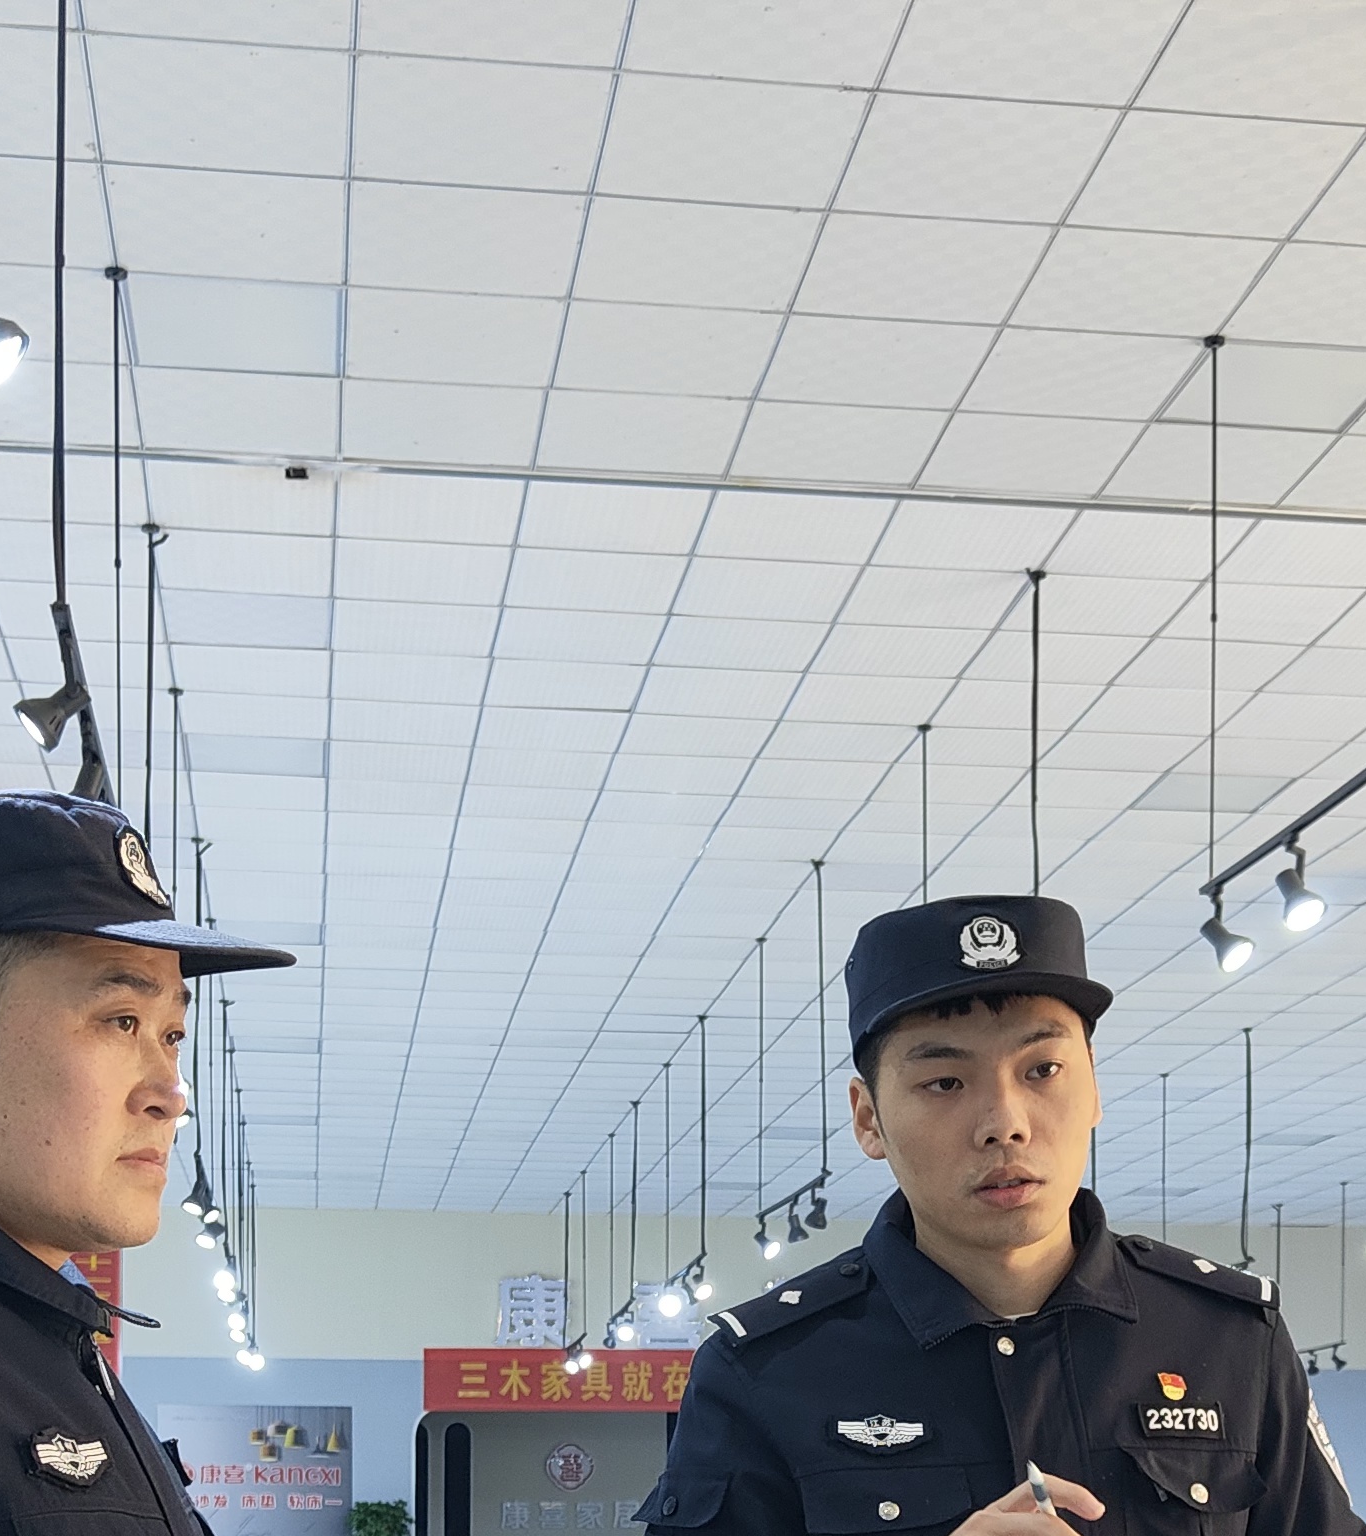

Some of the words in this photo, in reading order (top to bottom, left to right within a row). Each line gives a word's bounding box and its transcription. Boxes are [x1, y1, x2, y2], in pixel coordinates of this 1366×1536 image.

[978, 959, 1006, 969] POLICE
[457, 1358, 692, 1402] 三木家具就在
[869, 1418, 894, 1428] 江苏
[1146, 1407, 1219, 1432] 232730
[199, 1464, 245, 1485] 康喜
[240, 1494, 277, 1510] 床垫
